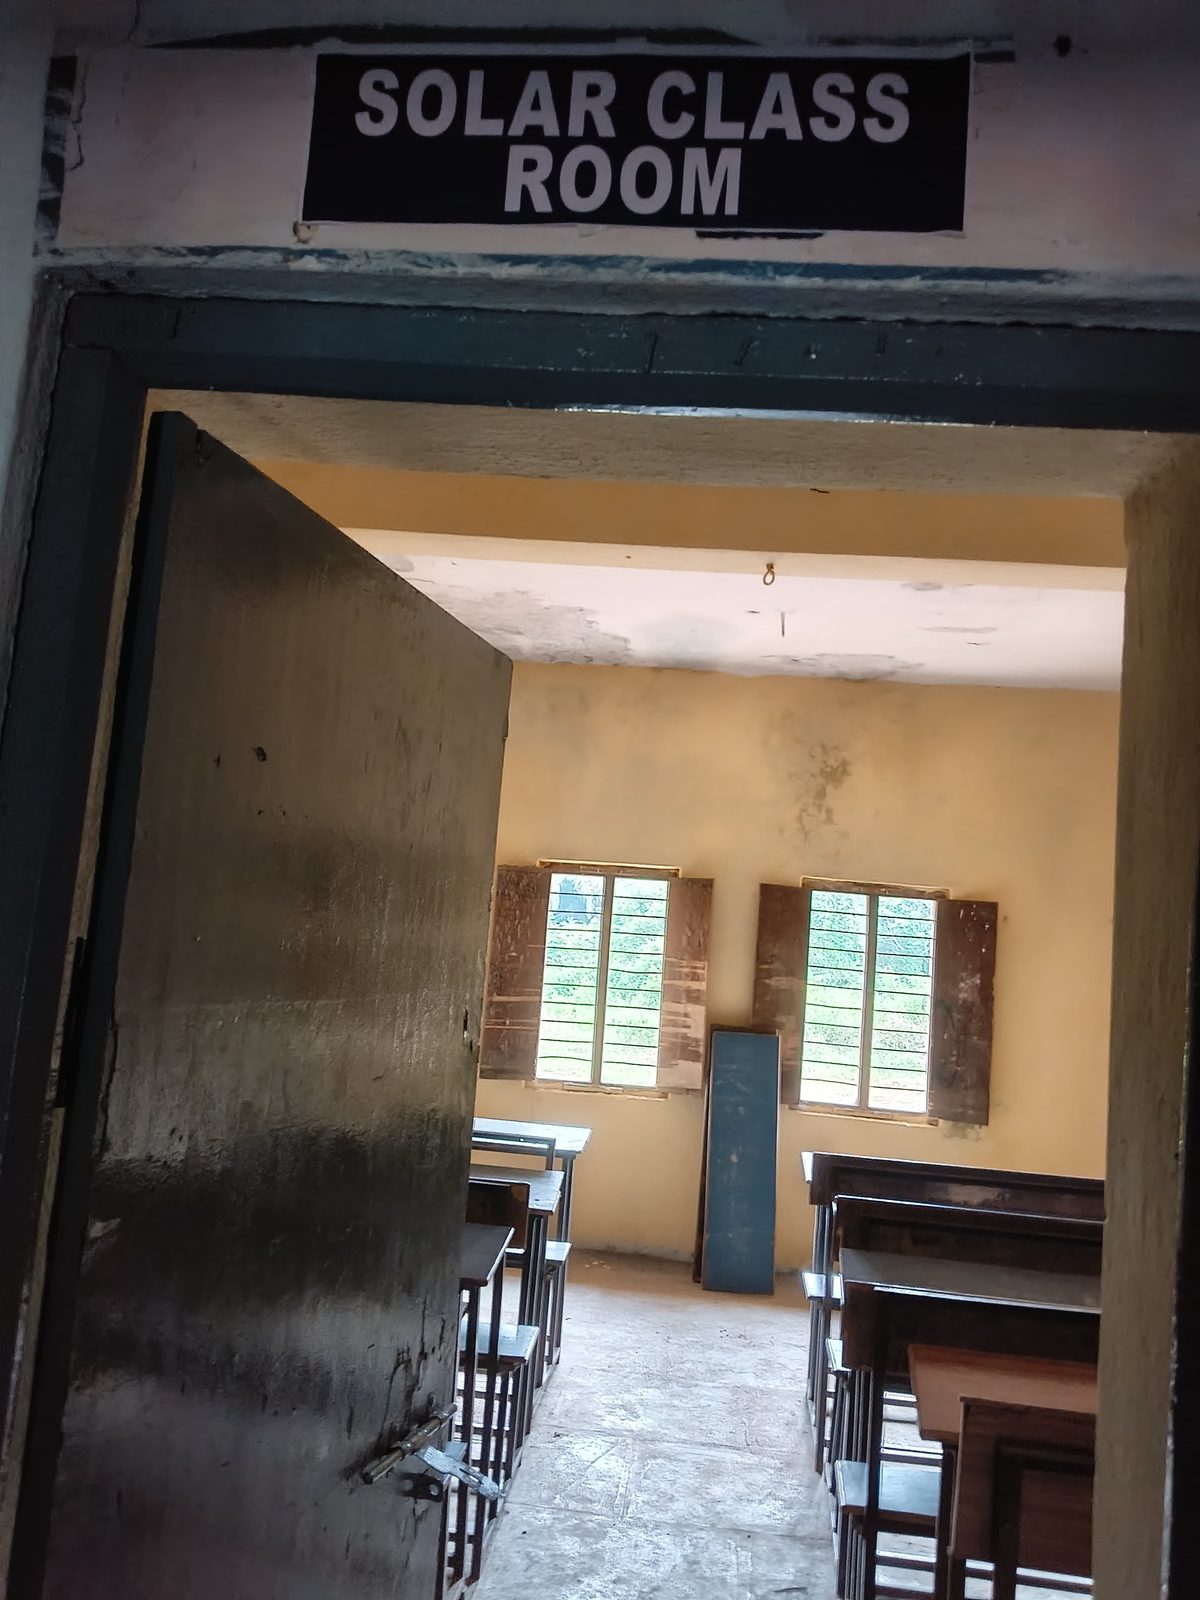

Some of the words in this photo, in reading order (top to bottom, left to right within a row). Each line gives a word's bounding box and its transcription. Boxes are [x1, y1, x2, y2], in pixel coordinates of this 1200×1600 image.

[355, 69, 617, 137] SOLAR
[648, 71, 910, 143] CLASS
[504, 145, 741, 215] ROOM
